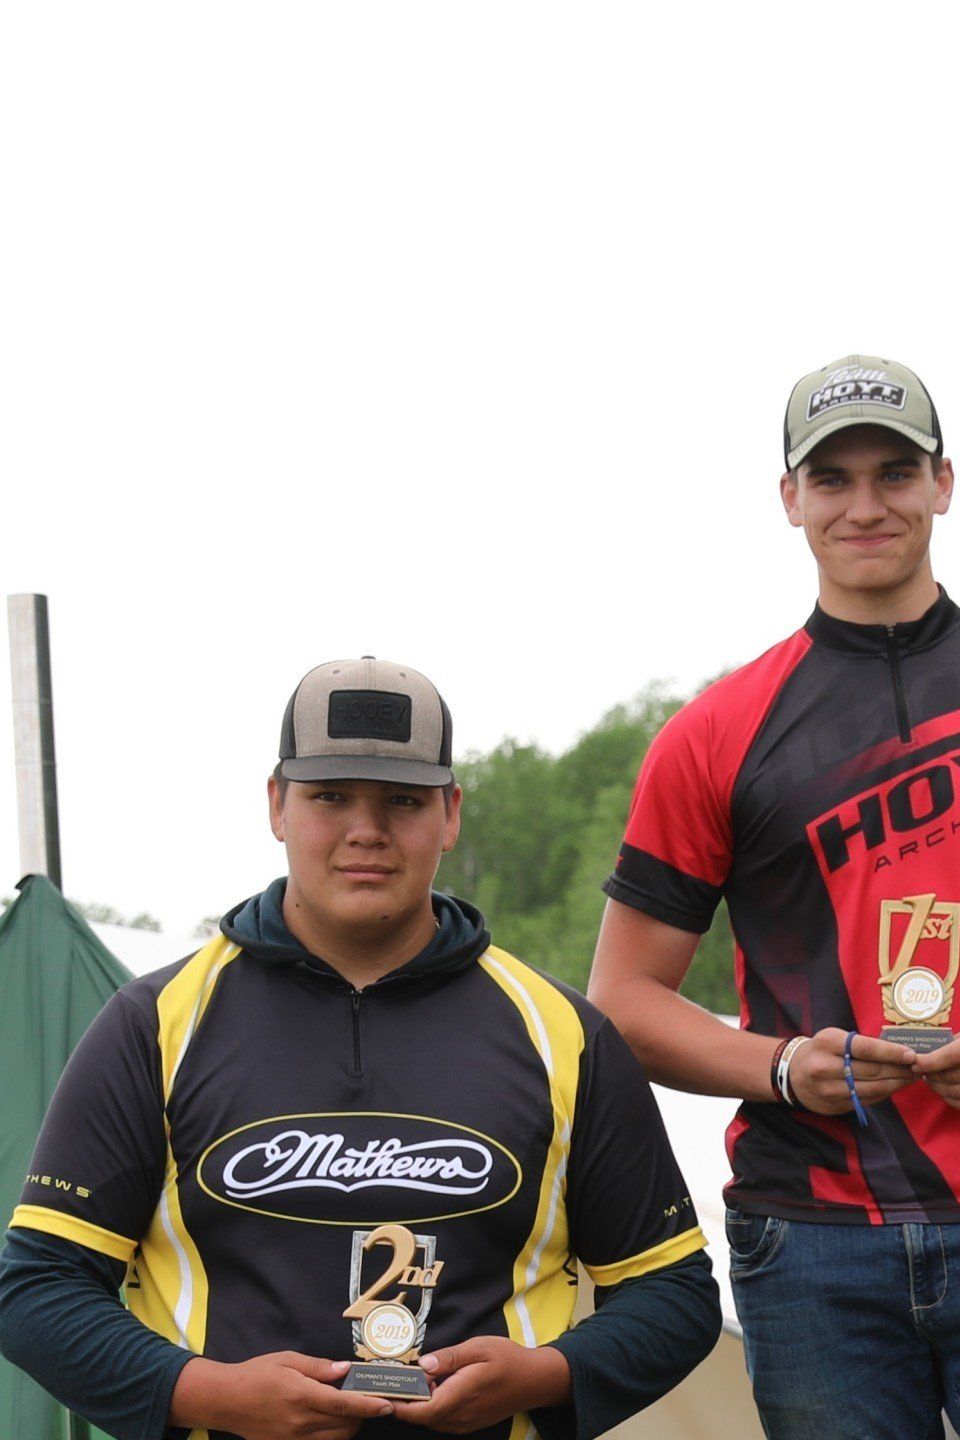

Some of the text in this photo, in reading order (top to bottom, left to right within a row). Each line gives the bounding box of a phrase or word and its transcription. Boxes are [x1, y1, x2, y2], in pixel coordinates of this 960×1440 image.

[906, 988, 939, 1003] 2019
[222, 1129, 493, 1191] Mathews
[374, 1324, 411, 1339] 2019
